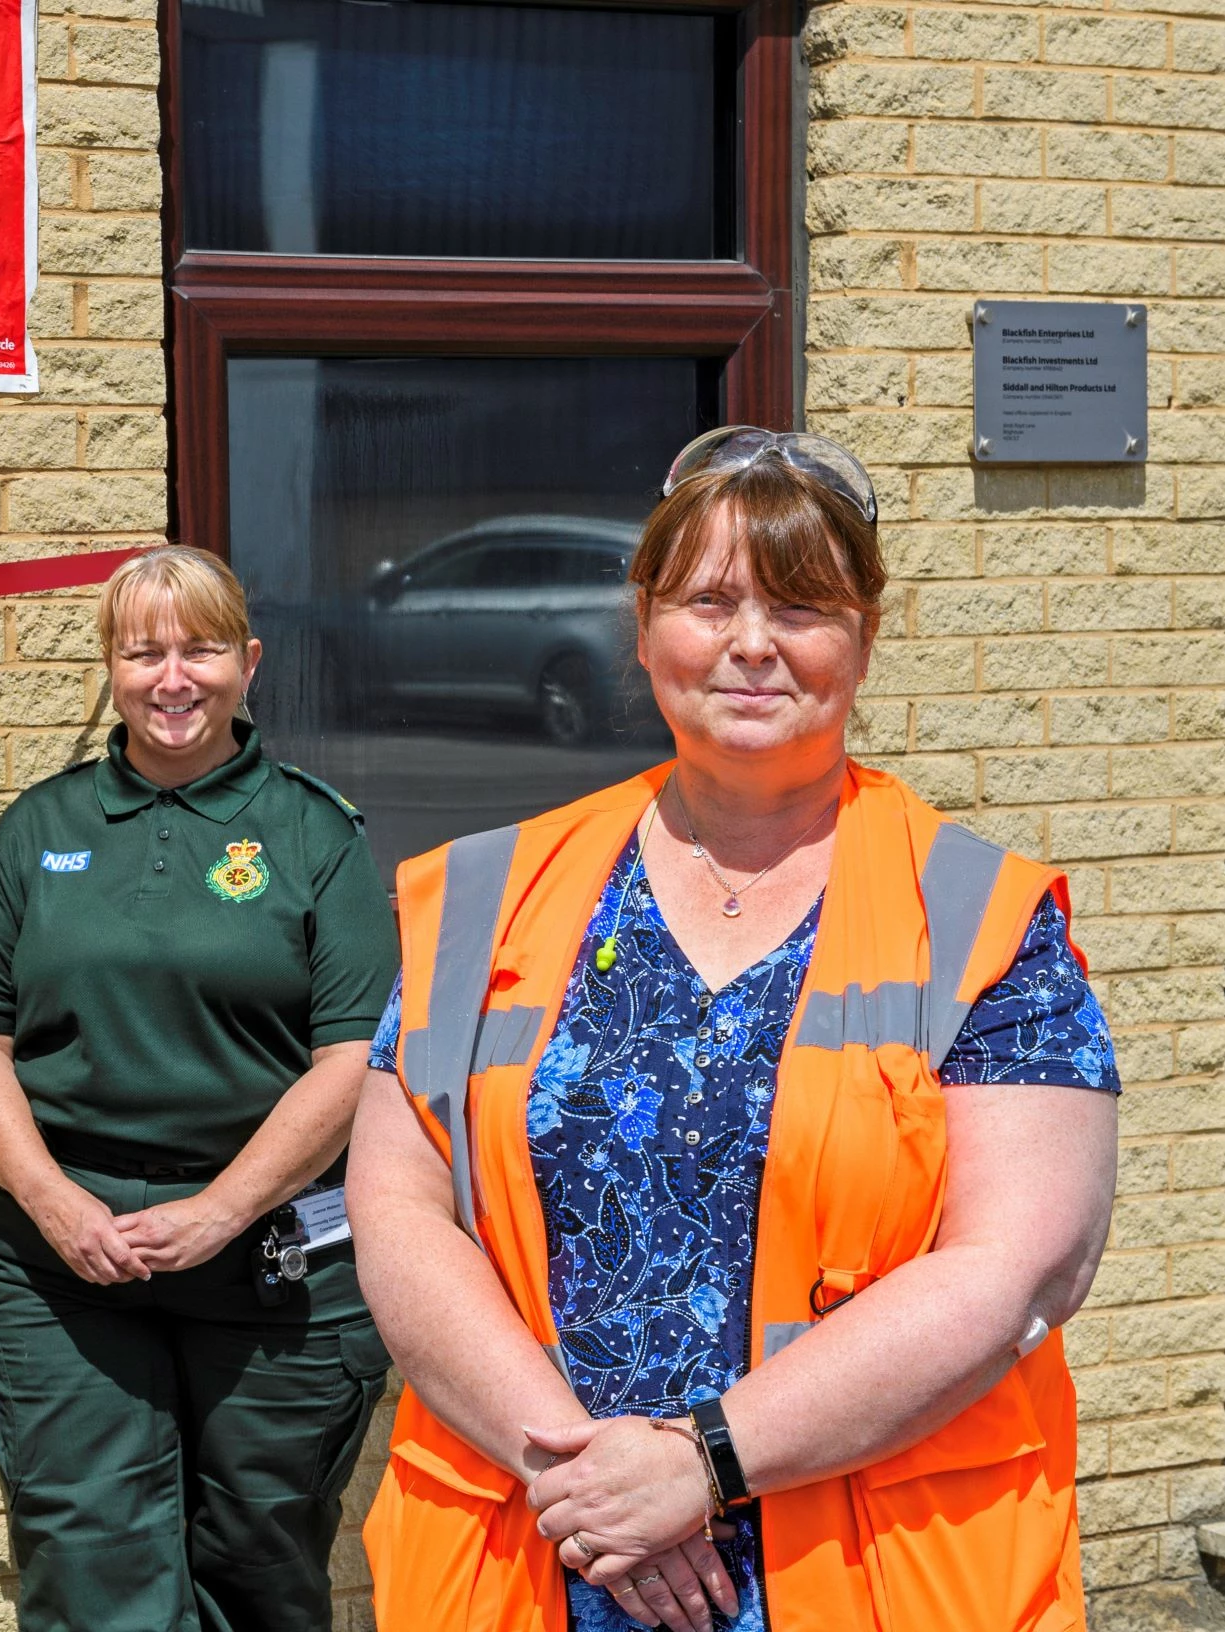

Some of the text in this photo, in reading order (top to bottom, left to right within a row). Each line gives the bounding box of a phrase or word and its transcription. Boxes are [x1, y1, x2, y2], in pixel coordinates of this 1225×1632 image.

[1002, 329, 1094, 339] Blackfish Enterprises Ltd
[1002, 356, 1098, 365] Blackfish Investments Ltd
[1002, 383, 1116, 392] Siddall and Hilton Products Ltd
[44, 853, 87, 870] NHS
